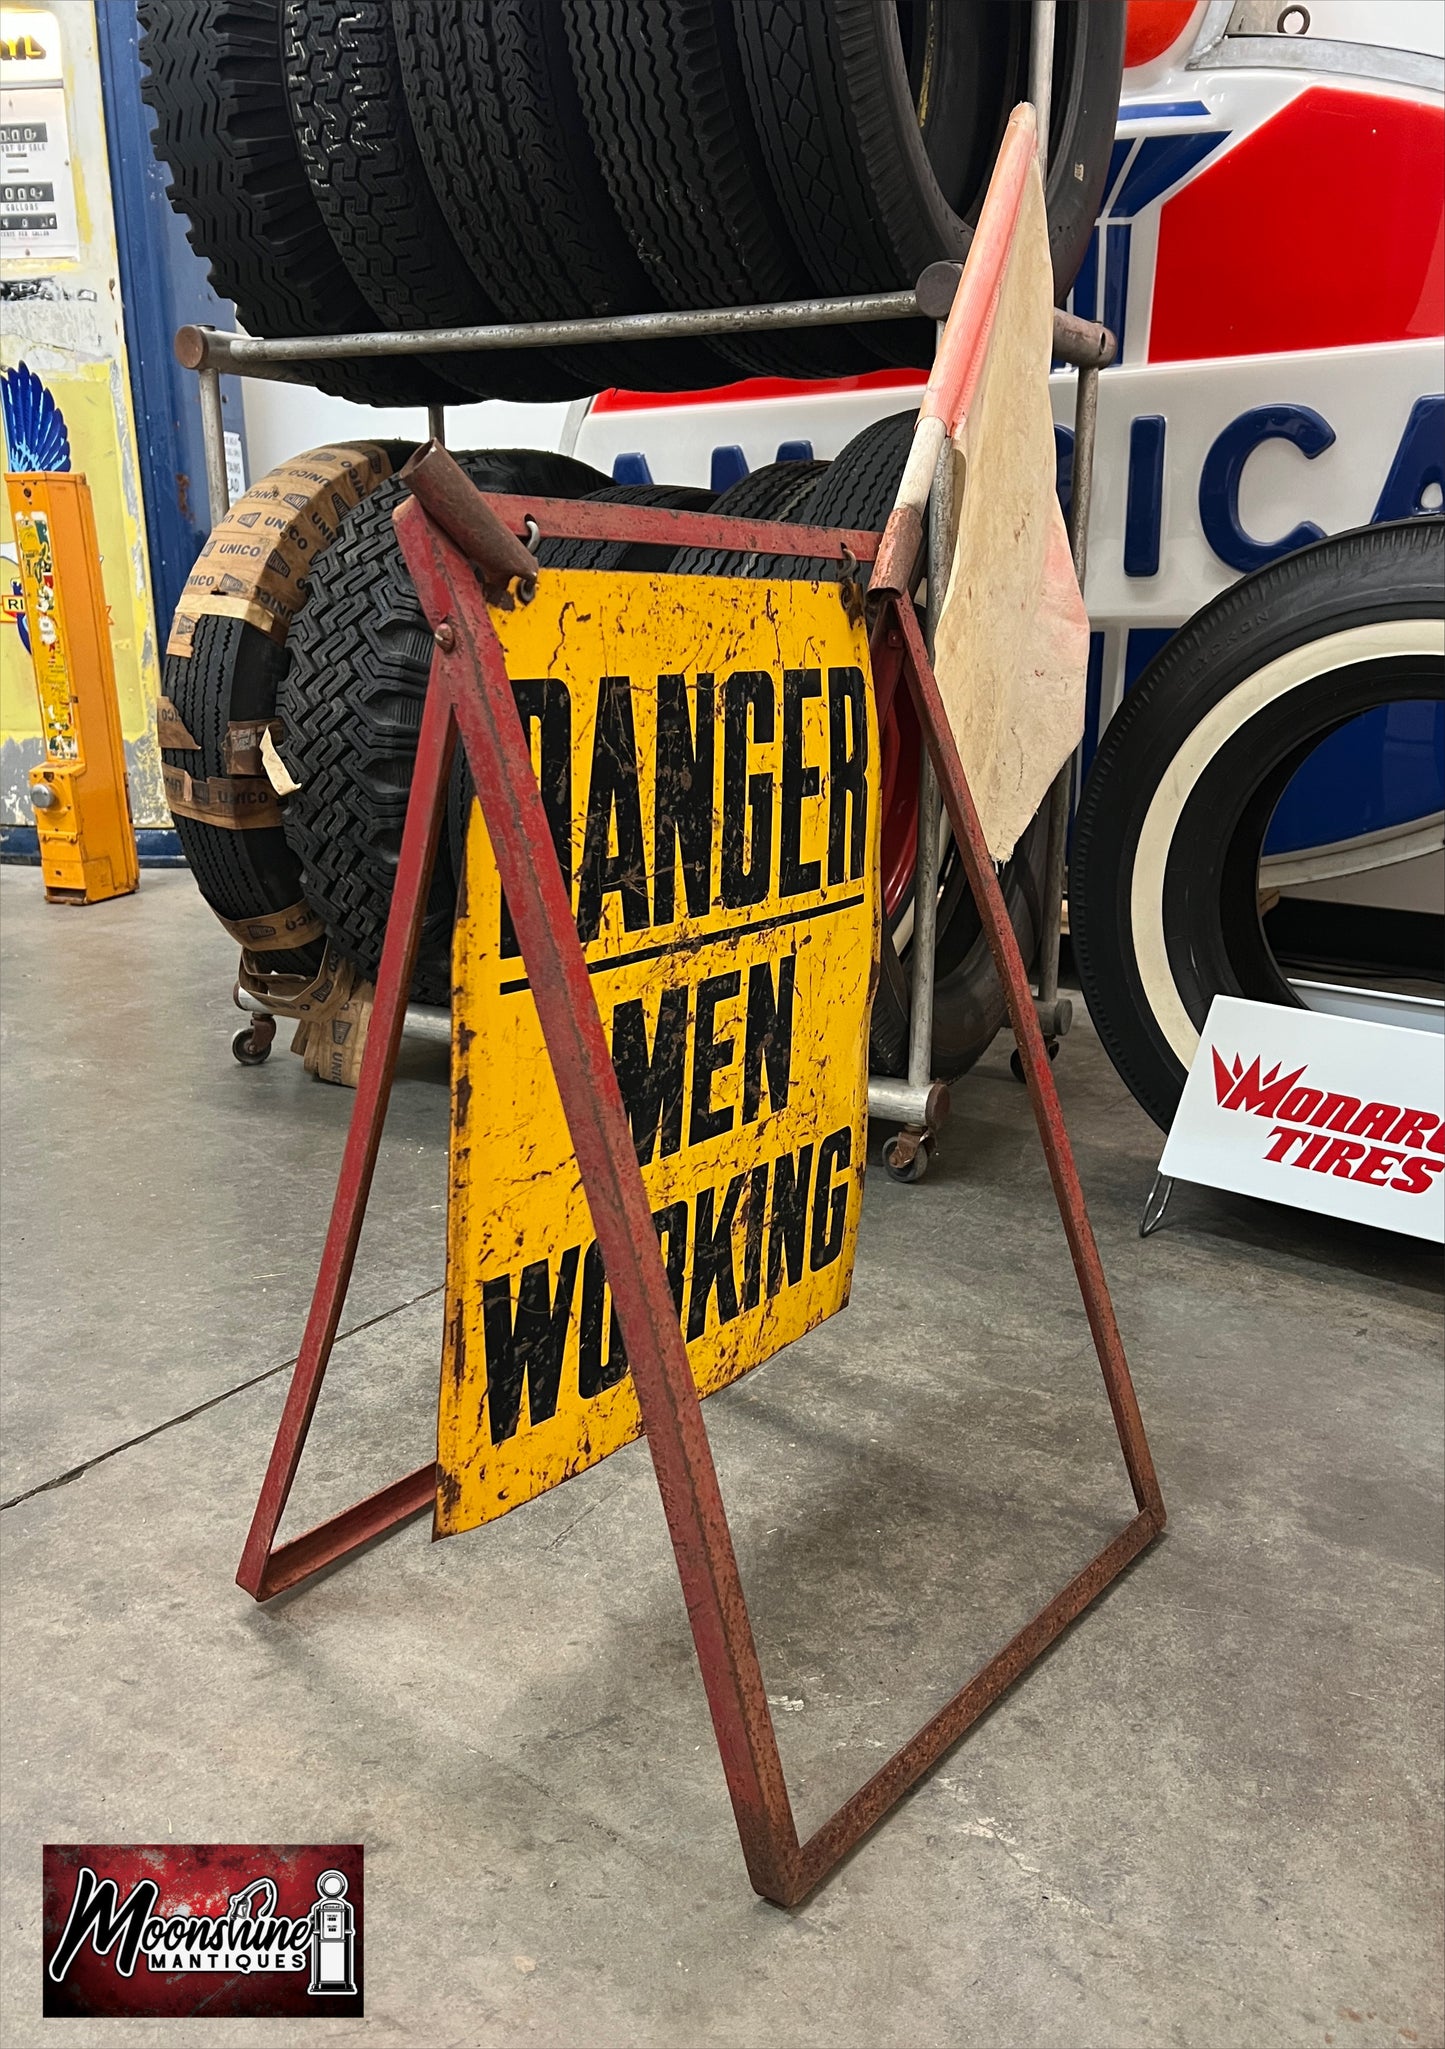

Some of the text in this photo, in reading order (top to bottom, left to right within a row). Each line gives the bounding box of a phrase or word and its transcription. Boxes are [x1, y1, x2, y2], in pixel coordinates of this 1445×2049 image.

[288, 469, 333, 488] UNICO
[219, 543, 261, 558] UNICO
[500, 666, 868, 960] DANGER
[610, 954, 797, 1168] MEN
[1262, 1126, 1444, 1194] TIRES
[482, 1126, 852, 1447] WORKING
